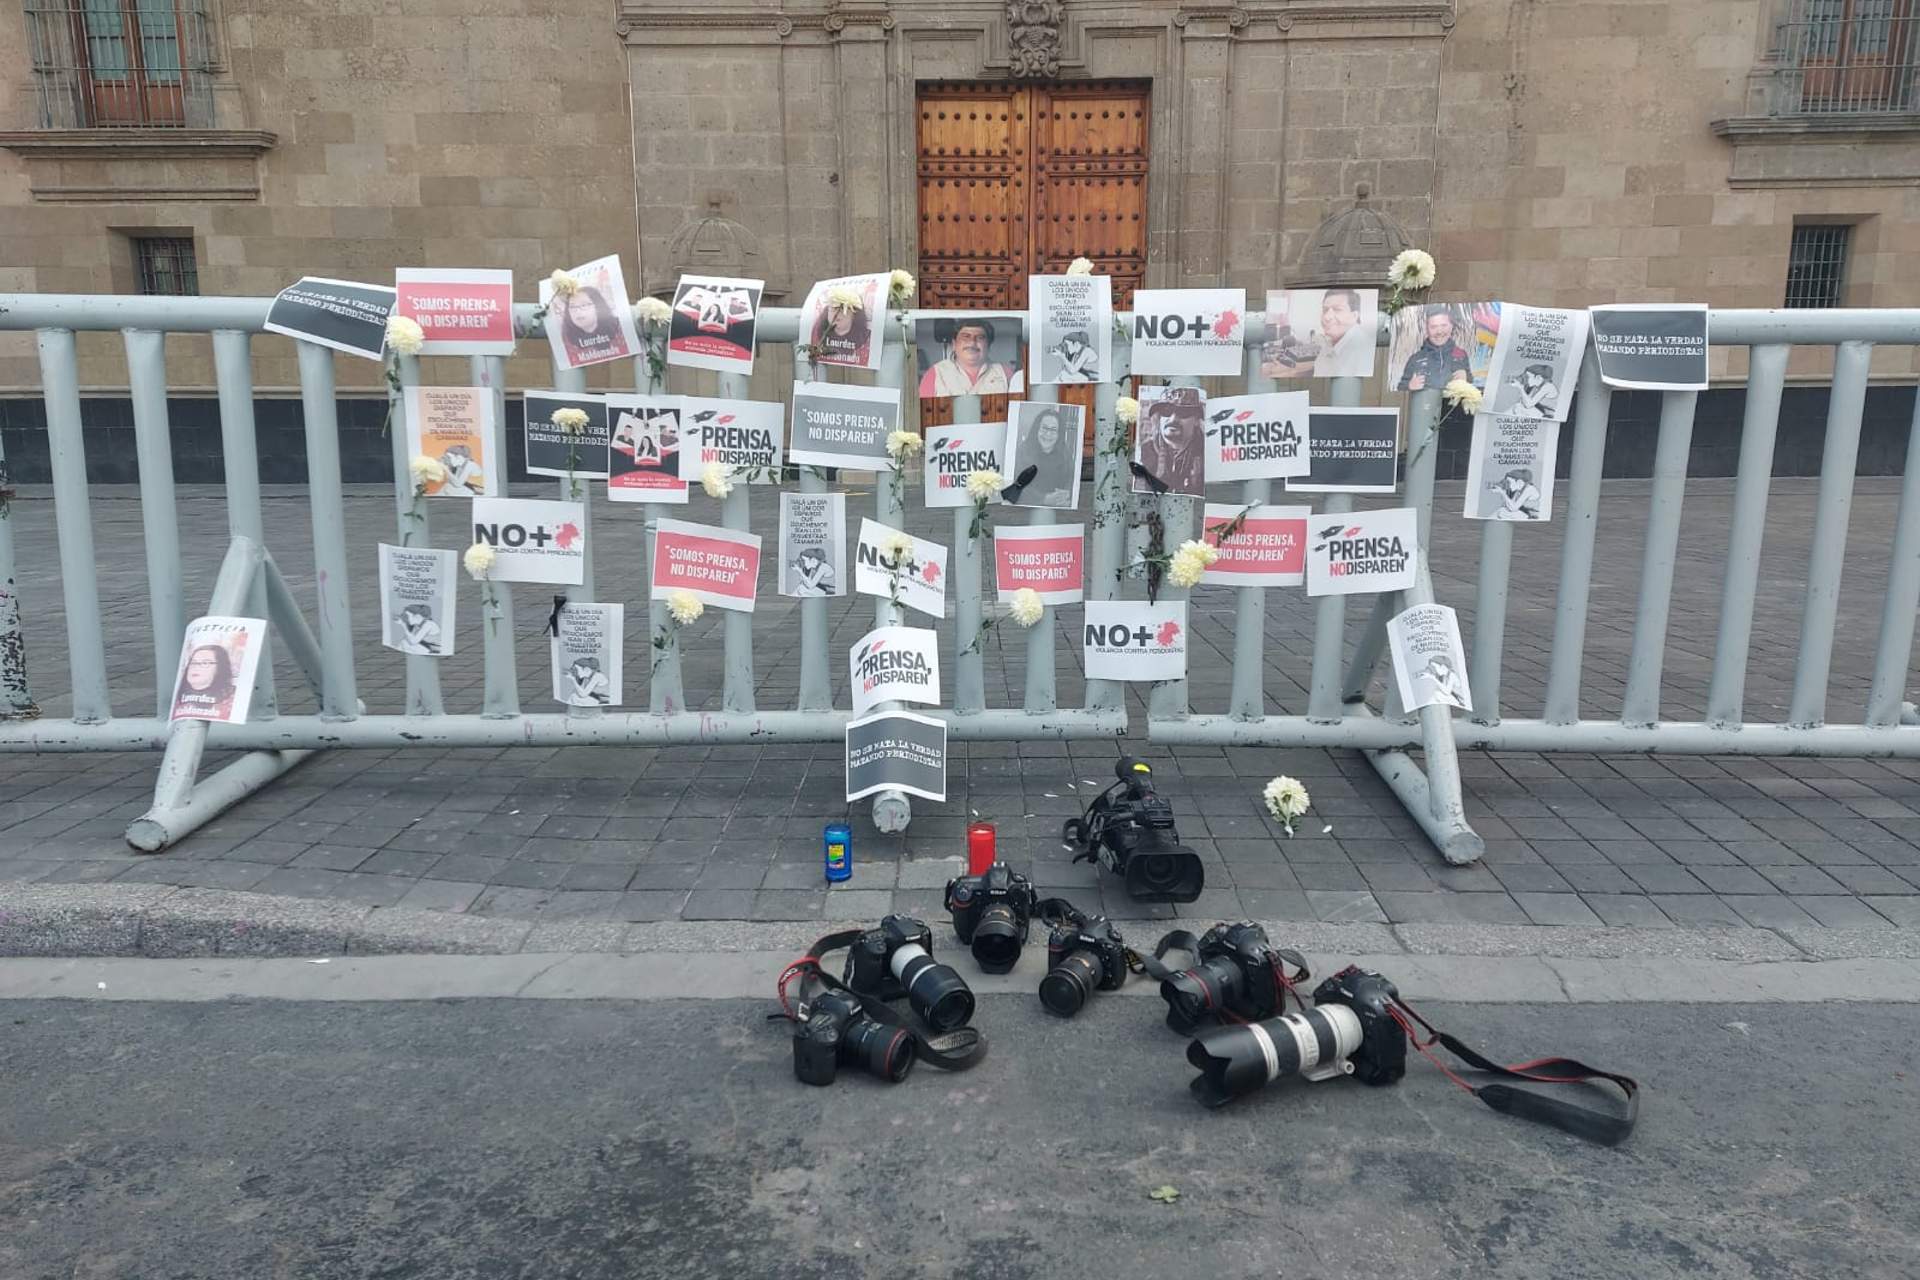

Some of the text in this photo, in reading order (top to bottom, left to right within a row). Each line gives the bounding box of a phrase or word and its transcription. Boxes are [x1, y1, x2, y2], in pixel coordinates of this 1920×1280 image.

[352, 300, 388, 315] VERDAD
[416, 314, 432, 327] NO
[826, 337, 856, 349] Lourdes
[1624, 335, 1649, 344] MATA
[1650, 336, 1662, 344] LA
[1664, 336, 1704, 345] VERDAD
[1638, 346, 1704, 356] PERIODISTAS
[702, 426, 776, 454] PRENSA,
[808, 427, 822, 440] NO
[1220, 420, 1302, 447] PRENSA,
[1358, 440, 1394, 448] VERDAD
[939, 450, 1000, 473] PRENSA,
[1329, 536, 1410, 561] PRENSA,
[670, 563, 684, 576] NO
[1012, 568, 1024, 580] NO
[862, 650, 932, 680] PRENSA,
[850, 748, 861, 759] NO
[898, 740, 909, 749] LA
[911, 742, 942, 758] VERDAD
[850, 751, 885, 769] MATANDO
